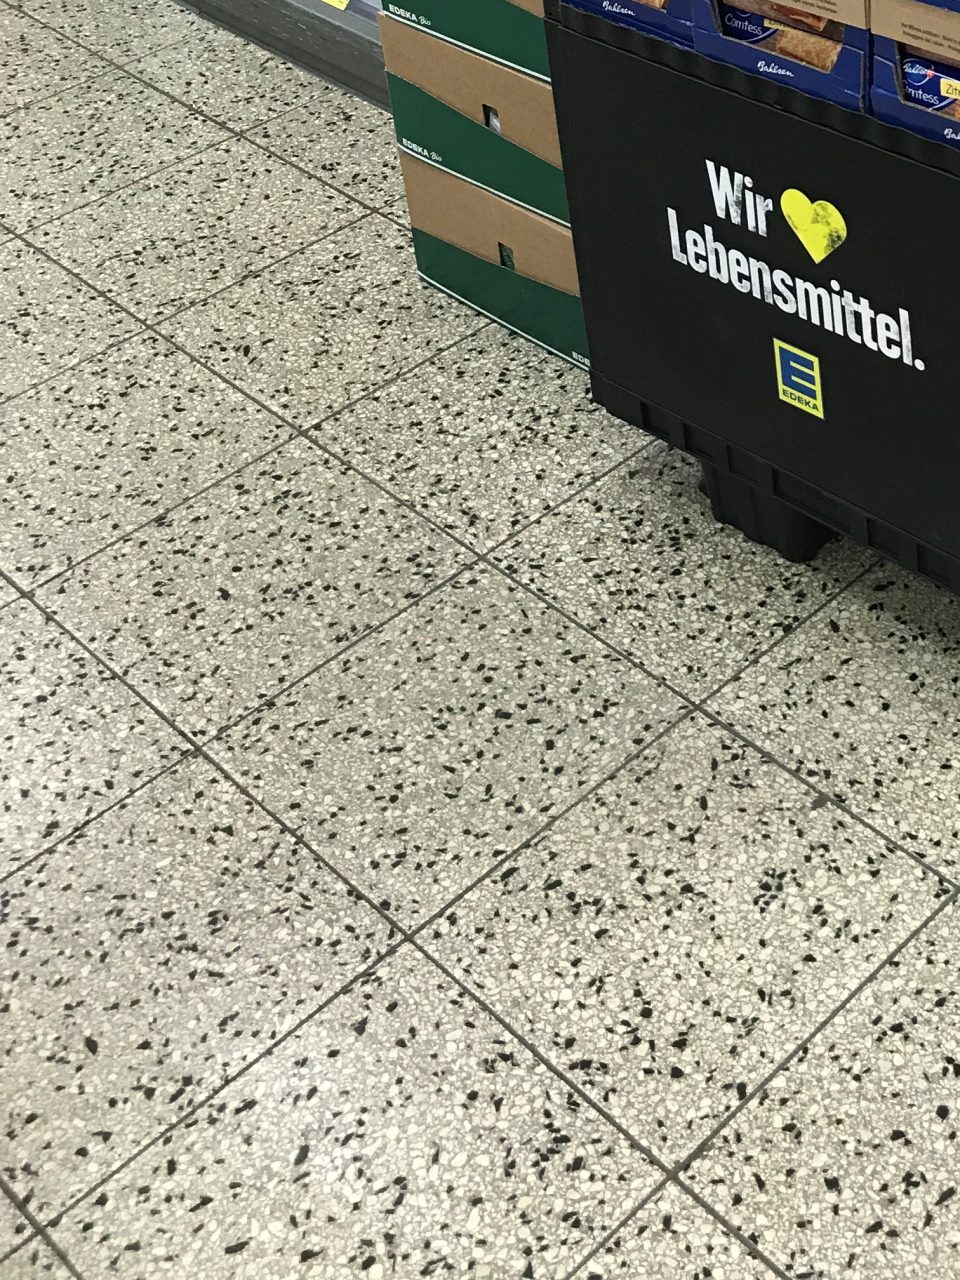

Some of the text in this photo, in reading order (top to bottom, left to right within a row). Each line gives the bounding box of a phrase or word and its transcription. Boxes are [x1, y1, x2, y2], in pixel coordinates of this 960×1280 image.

[388, 4, 432, 26] EDEKA Bio
[602, 0, 636, 16] Bahlsen
[724, 13, 763, 36] Comtess
[757, 60, 794, 78] Bahlsen
[402, 137, 443, 162] EDEKA Bio
[705, 159, 774, 238] Wir
[667, 207, 925, 371] Lebensmittel.
[782, 388, 820, 413] EDEKA
